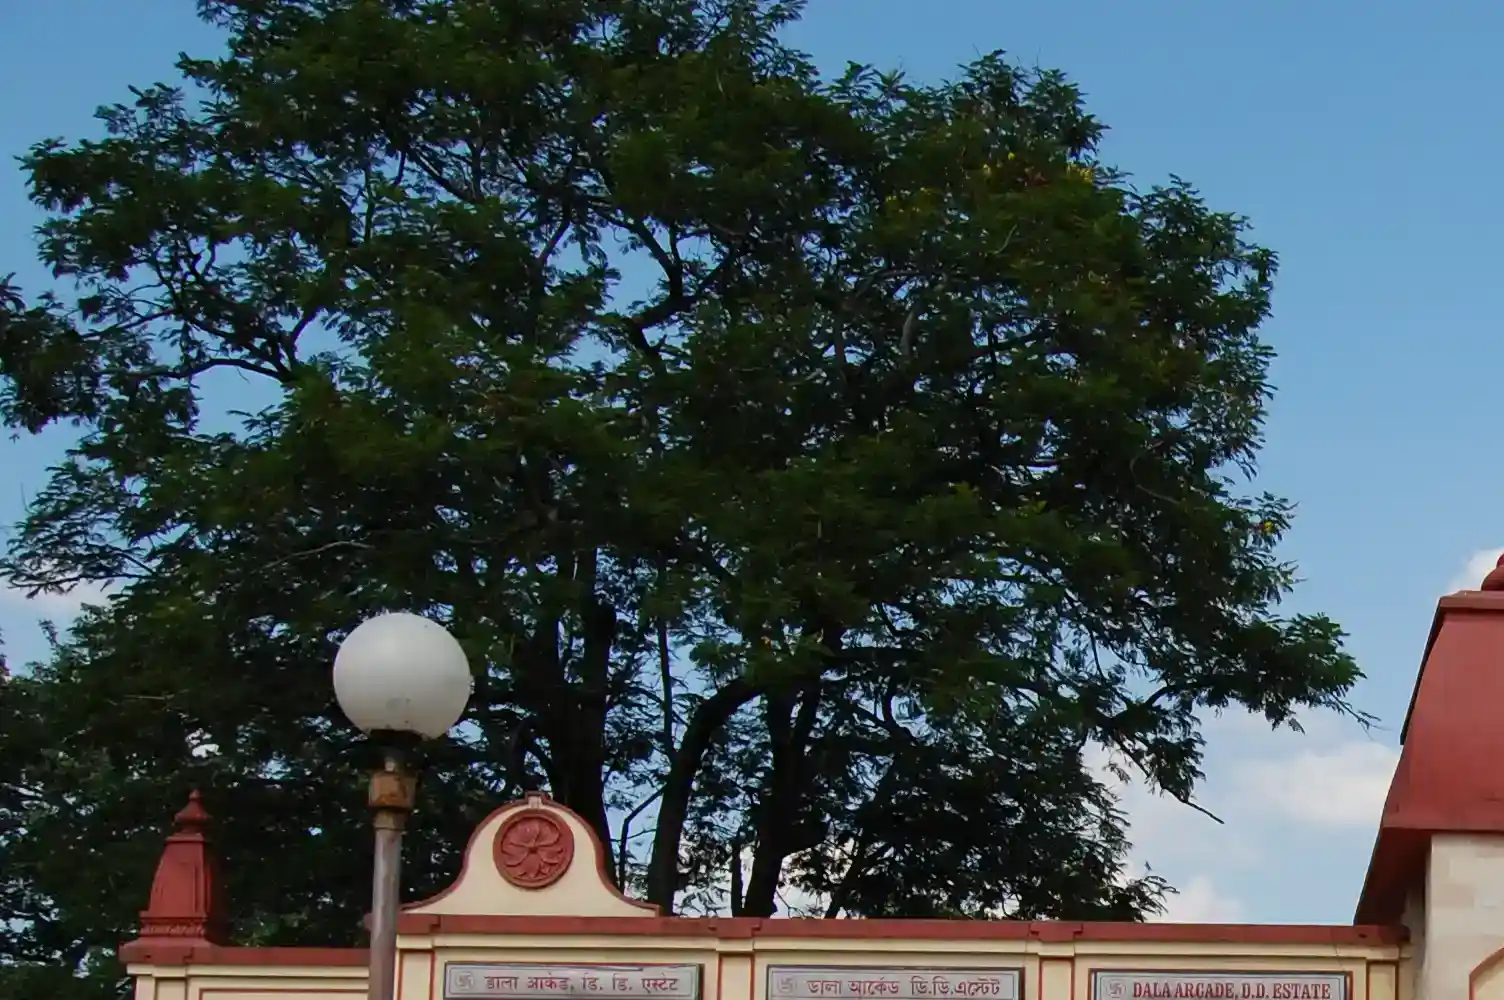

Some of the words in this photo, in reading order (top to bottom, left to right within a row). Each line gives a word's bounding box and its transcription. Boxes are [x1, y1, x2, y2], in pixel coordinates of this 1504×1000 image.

[484, 976, 519, 990] डाला
[641, 972, 679, 993] एस्टेट
[807, 979, 843, 995] ডালা
[848, 976, 900, 997] আর্কেড
[1132, 981, 1172, 999] DALA
[1241, 982, 1269, 999] D.D.
[1272, 983, 1331, 1000] ESTATE
